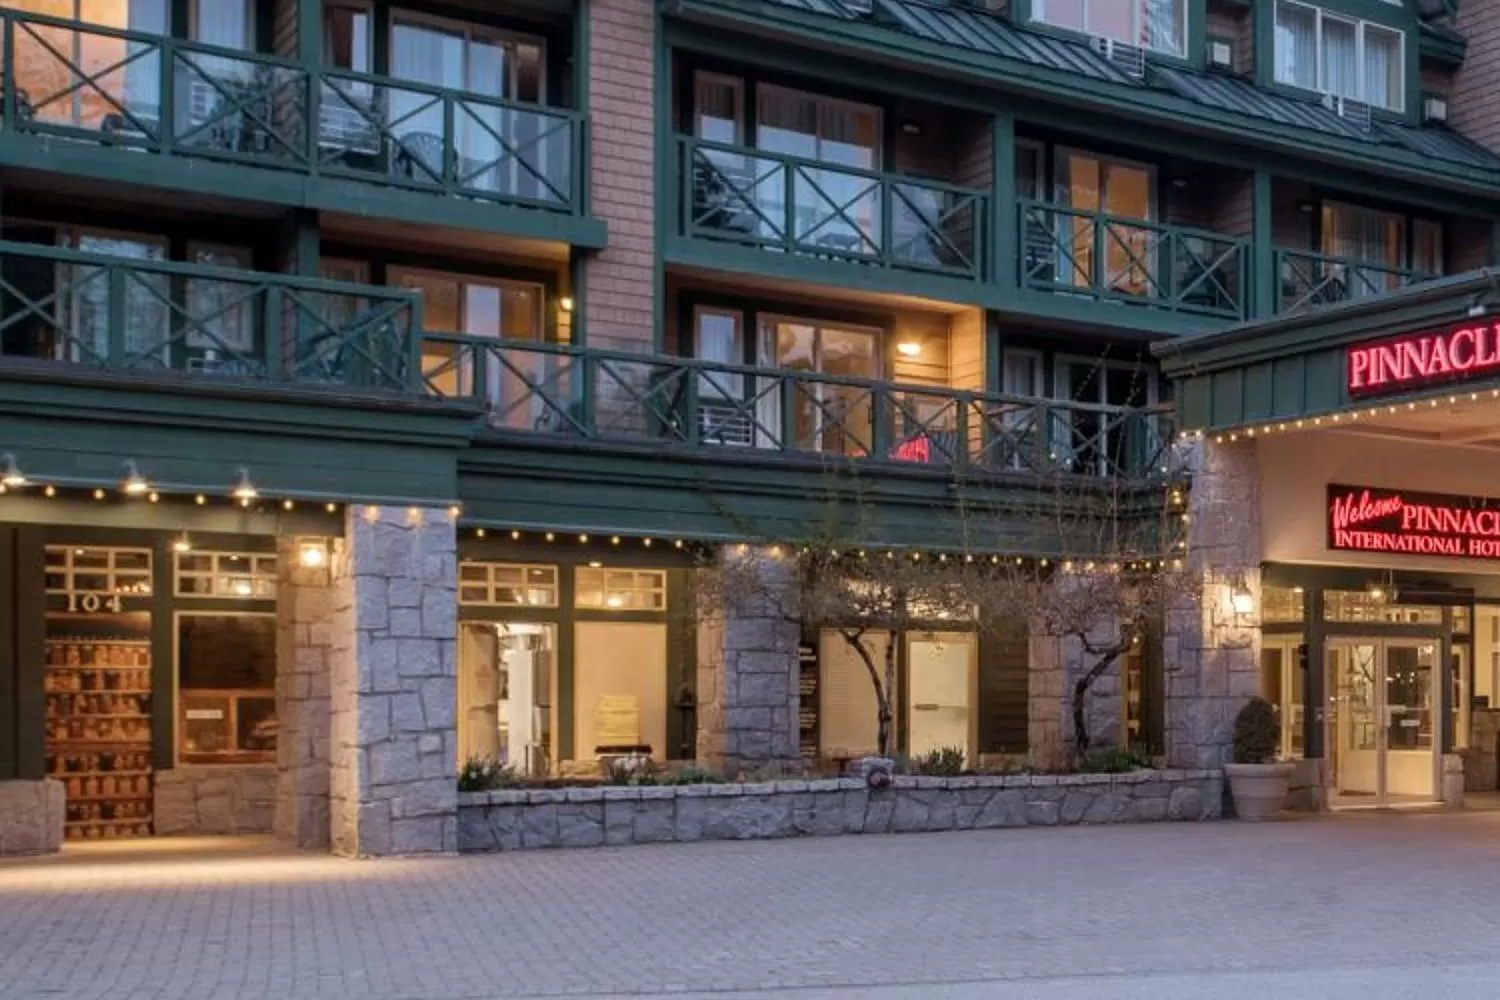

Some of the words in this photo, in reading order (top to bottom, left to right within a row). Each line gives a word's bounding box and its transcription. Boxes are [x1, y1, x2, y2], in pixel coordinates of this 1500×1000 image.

[1332, 490, 1402, 530] Welcome
[1335, 530, 1464, 555] INTERNATIONAL
[68, 592, 122, 613] 104
